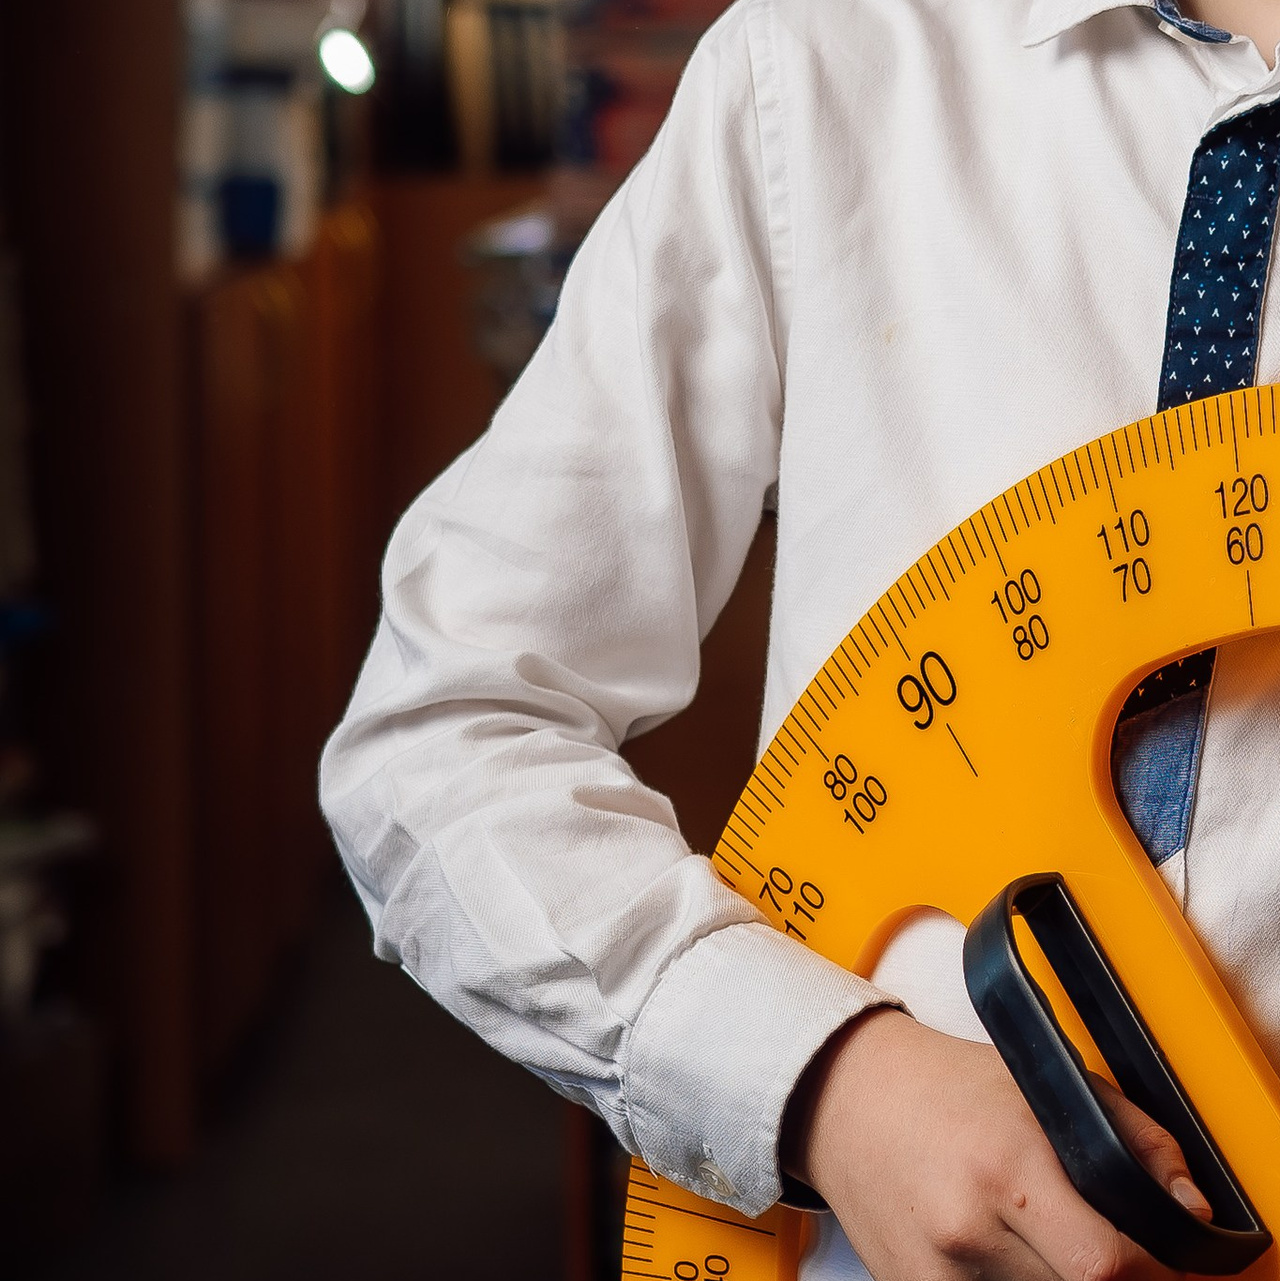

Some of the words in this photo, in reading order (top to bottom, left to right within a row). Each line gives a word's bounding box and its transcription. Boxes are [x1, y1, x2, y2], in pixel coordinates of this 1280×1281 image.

[1214, 474, 1269, 520] 120
[1097, 509, 1150, 561] 110
[1226, 523, 1264, 565] 60
[991, 569, 1042, 624] 100
[1112, 557, 1153, 602] 70
[1013, 615, 1050, 661] 80
[897, 651, 957, 731] 90
[823, 754, 858, 802] 80
[843, 775, 888, 835] 100
[759, 867, 793, 913] 70
[784, 881, 825, 940] 110
